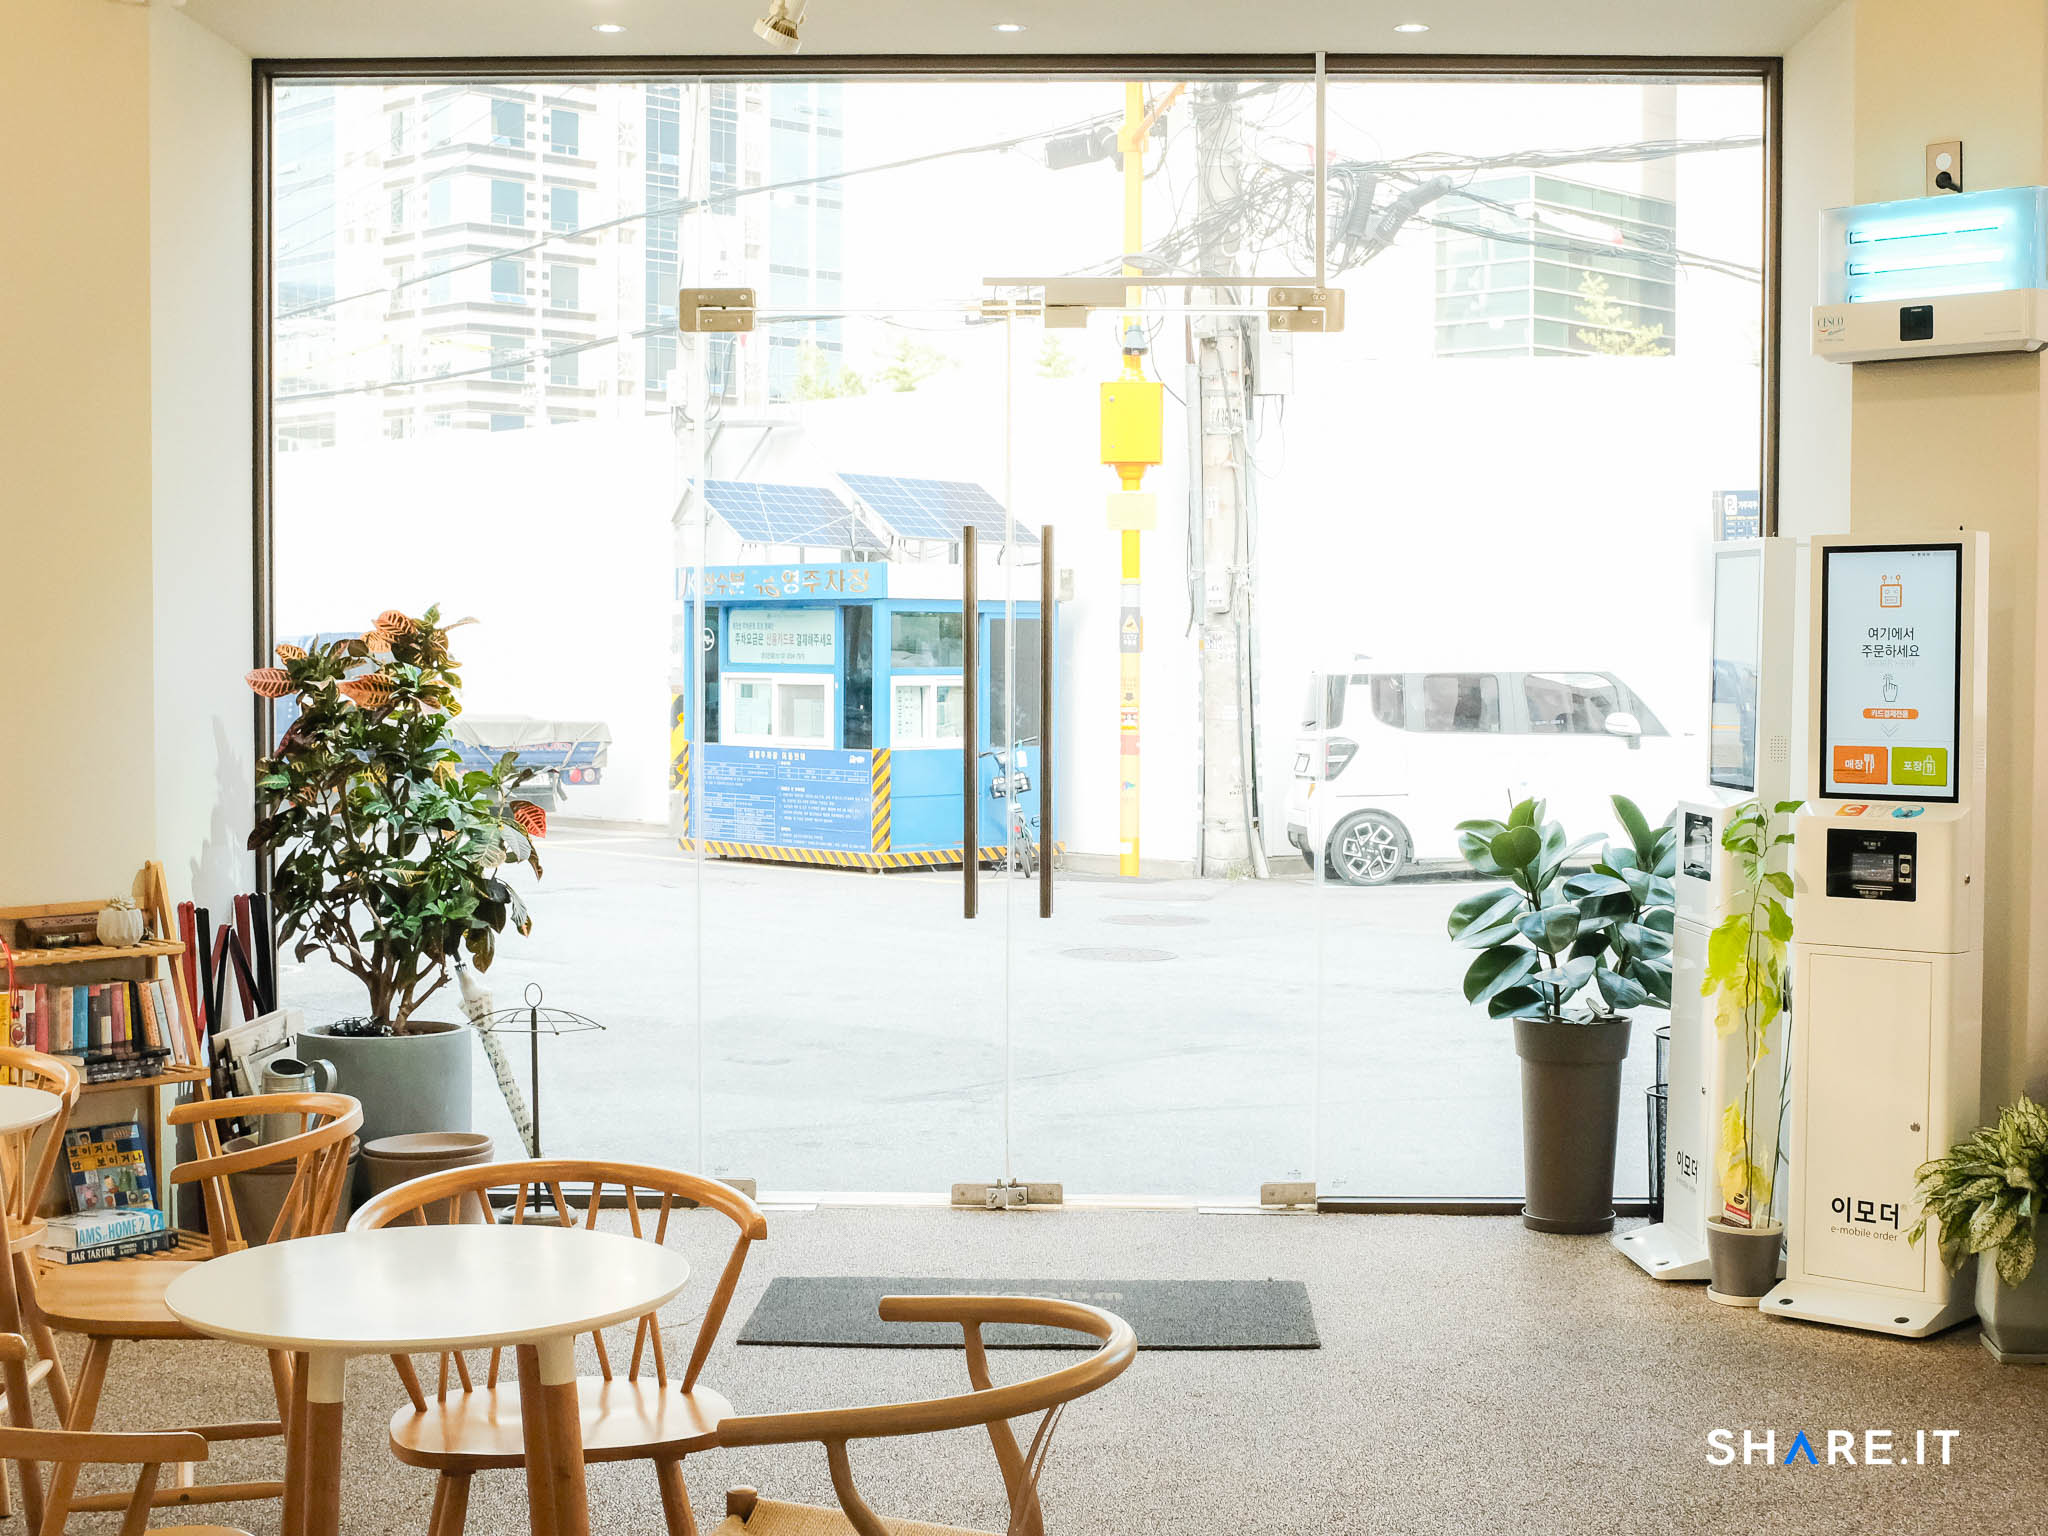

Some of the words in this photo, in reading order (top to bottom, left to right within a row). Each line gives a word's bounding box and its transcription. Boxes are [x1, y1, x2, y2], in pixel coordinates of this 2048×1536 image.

[735, 632, 764, 646] 주차요금은
[1868, 627, 1914, 641] 여기에서
[1861, 644, 1920, 658] 주문하세요
[1844, 759, 1864, 770] 매장
[1903, 761, 1922, 771] 포장
[70, 1142, 115, 1157] 보이거나
[72, 1160, 81, 1170] 안
[97, 1153, 143, 1167] 보이거나
[1676, 1151, 1698, 1184] 이모더
[1831, 1197, 1899, 1230] 이모더
[108, 1218, 138, 1240] HOME
[138, 1216, 146, 1233] 2
[152, 1214, 160, 1231] 2
[1831, 1225, 1871, 1238] e-mobile
[1873, 1231, 1897, 1241] order
[71, 1250, 86, 1263] BAR
[87, 1246, 116, 1260] TARTINE
